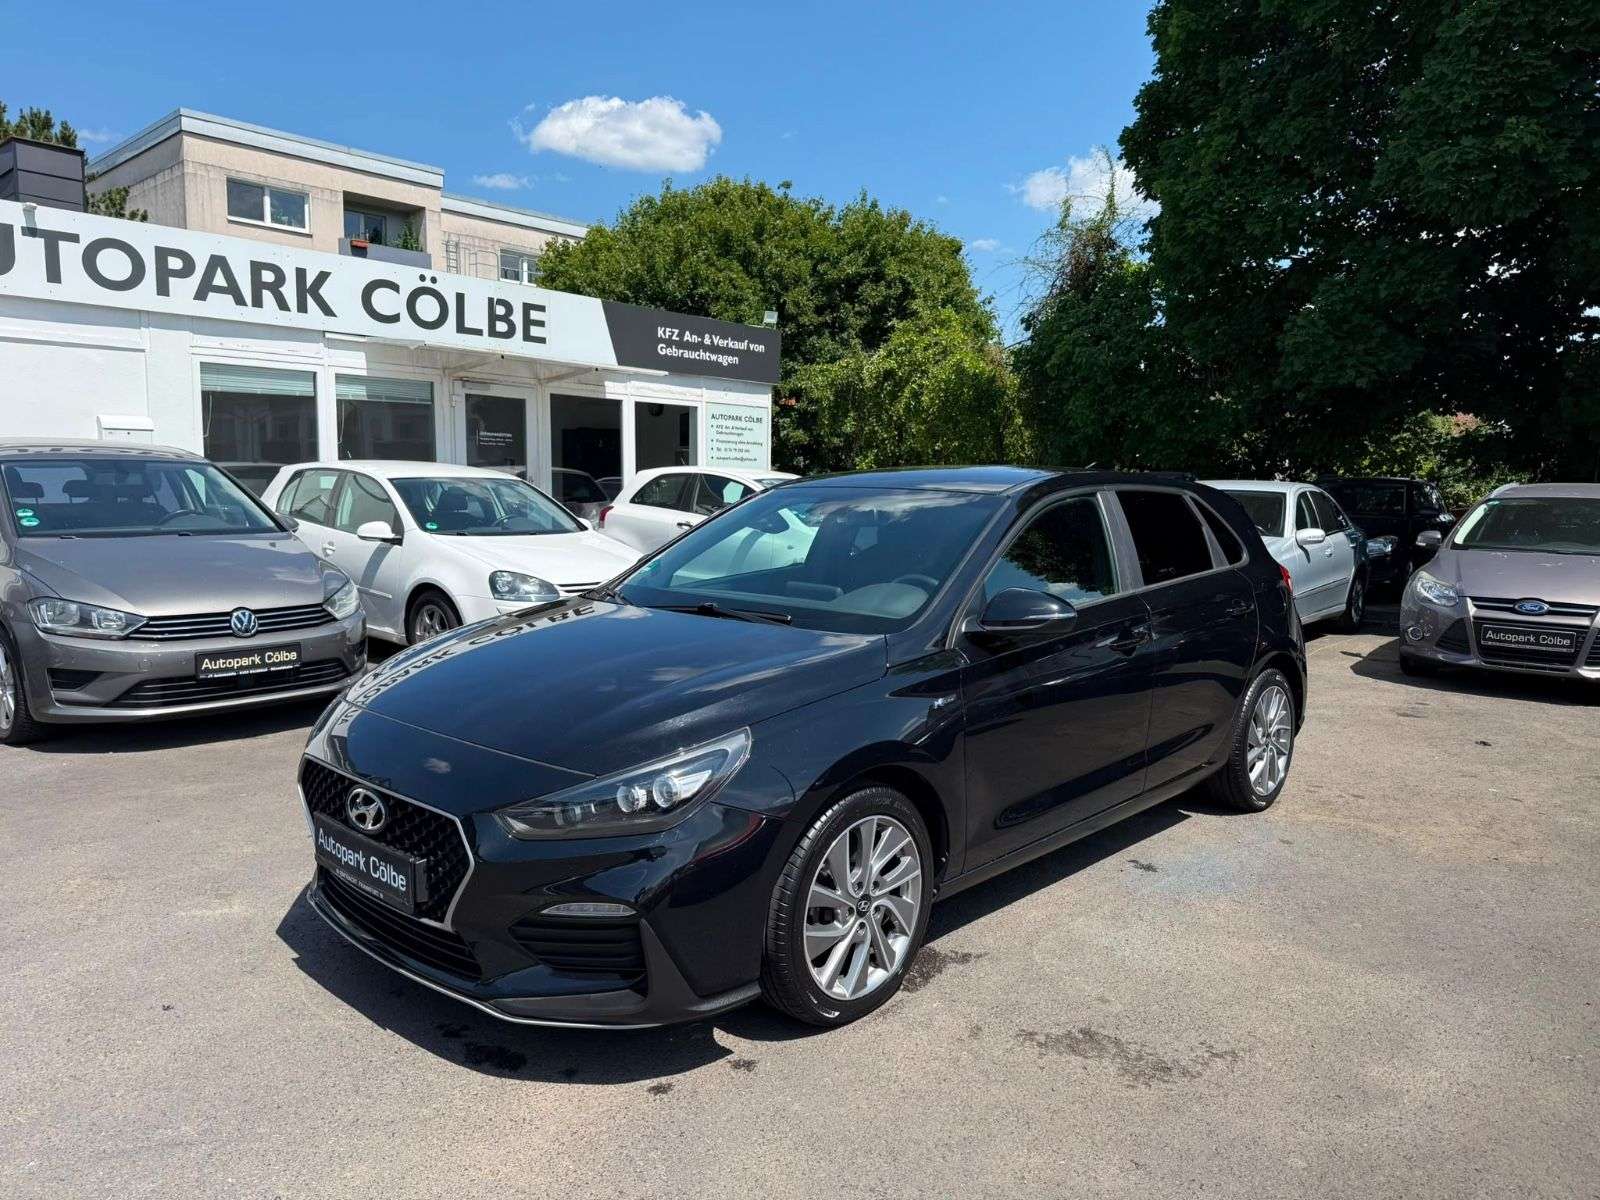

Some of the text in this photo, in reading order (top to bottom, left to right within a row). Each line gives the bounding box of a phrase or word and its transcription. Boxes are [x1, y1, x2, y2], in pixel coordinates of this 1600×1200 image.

[361, 273, 547, 345] CÖLBE
[657, 326, 765, 353] KFZ An- & Verkauf von
[657, 343, 739, 366] Gebrauchtwagen
[711, 413, 743, 421] AUTOPARK
[1485, 630, 1536, 643] Autopark
[201, 653, 261, 670] Autopark
[318, 827, 367, 873] Autopark
[369, 855, 407, 892] Cölbe
